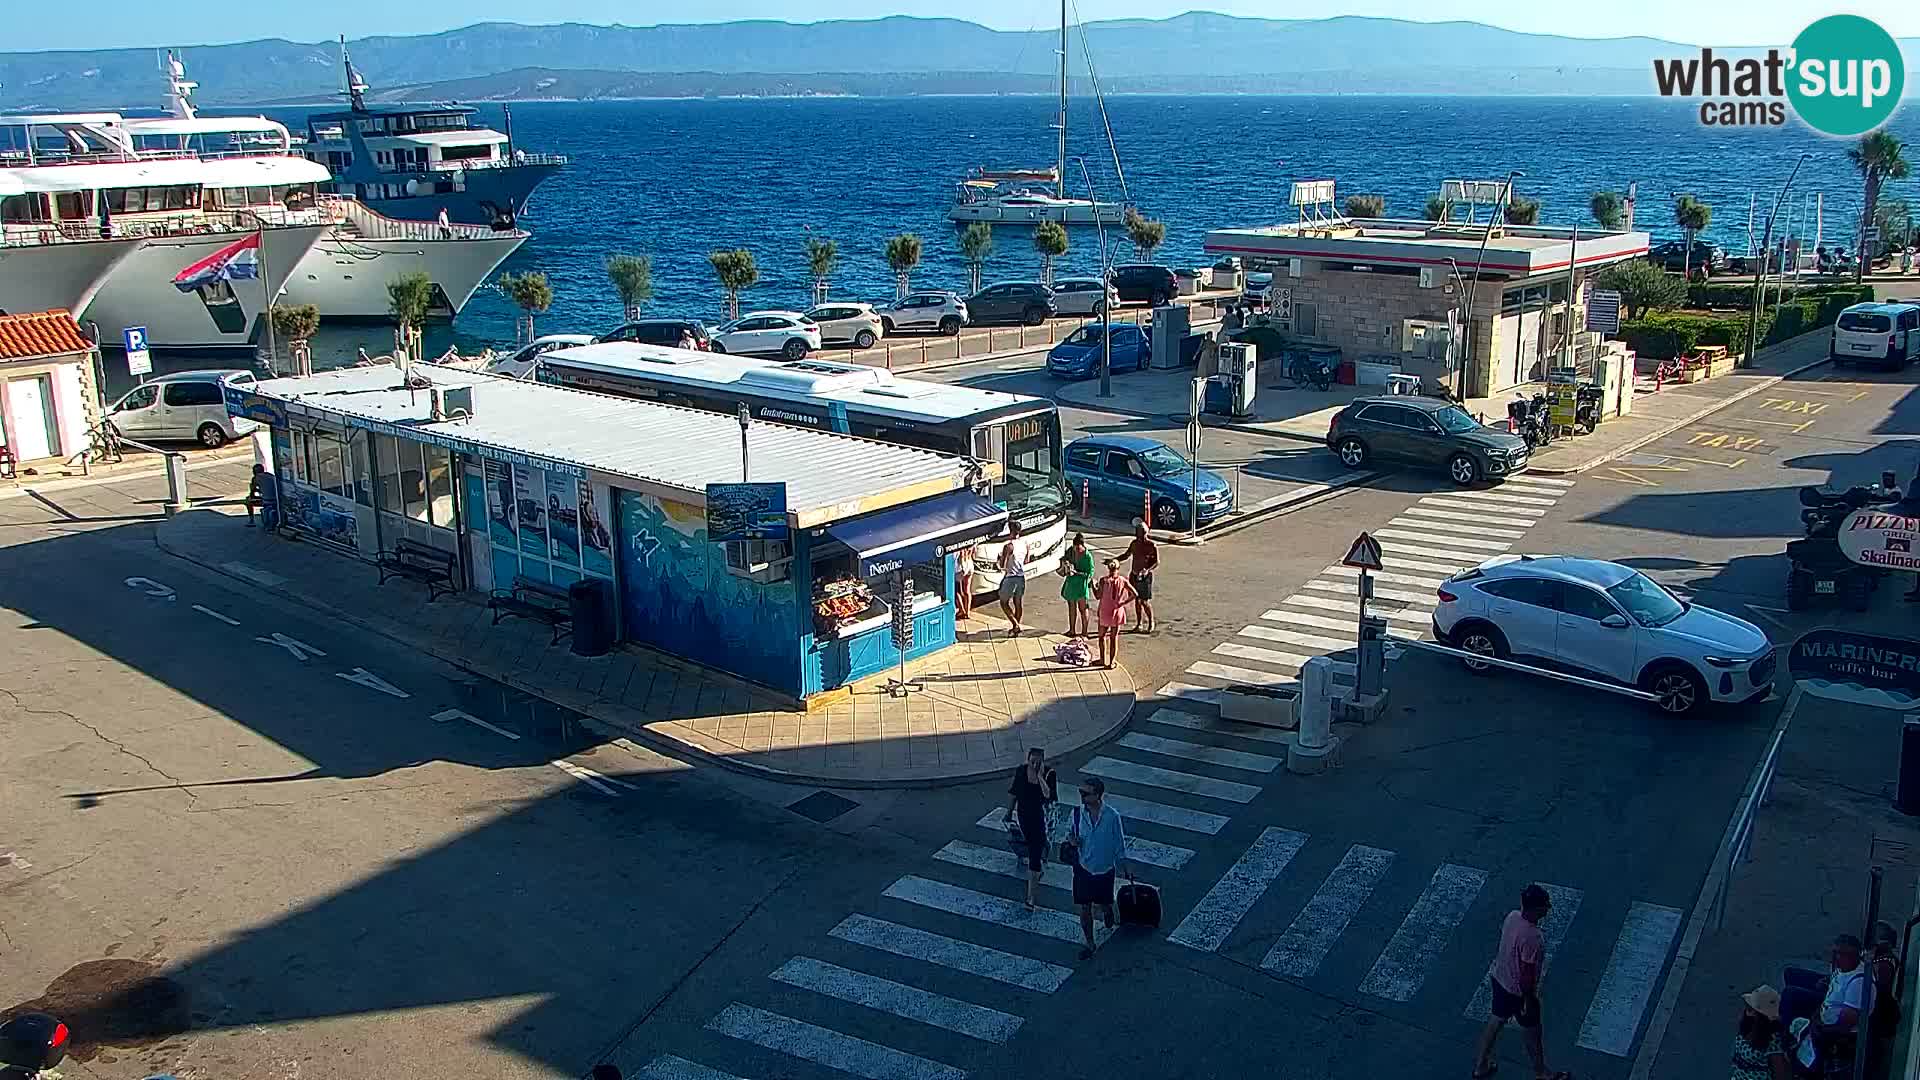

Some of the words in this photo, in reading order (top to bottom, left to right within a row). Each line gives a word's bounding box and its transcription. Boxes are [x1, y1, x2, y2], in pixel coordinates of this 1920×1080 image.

[129, 330, 143, 350] P
[1758, 397, 1830, 415] TAXI
[1686, 431, 1765, 451] TAXI
[436, 437, 469, 453] POSTAJA
[478, 446, 493, 459] BUS
[494, 449, 526, 465] STATION
[528, 458, 554, 472] TICKET
[555, 463, 583, 478] OFFICE
[1881, 530, 1918, 541] GRILL
[1829, 662, 1866, 675] caffe
[1871, 665, 1897, 681] bar
